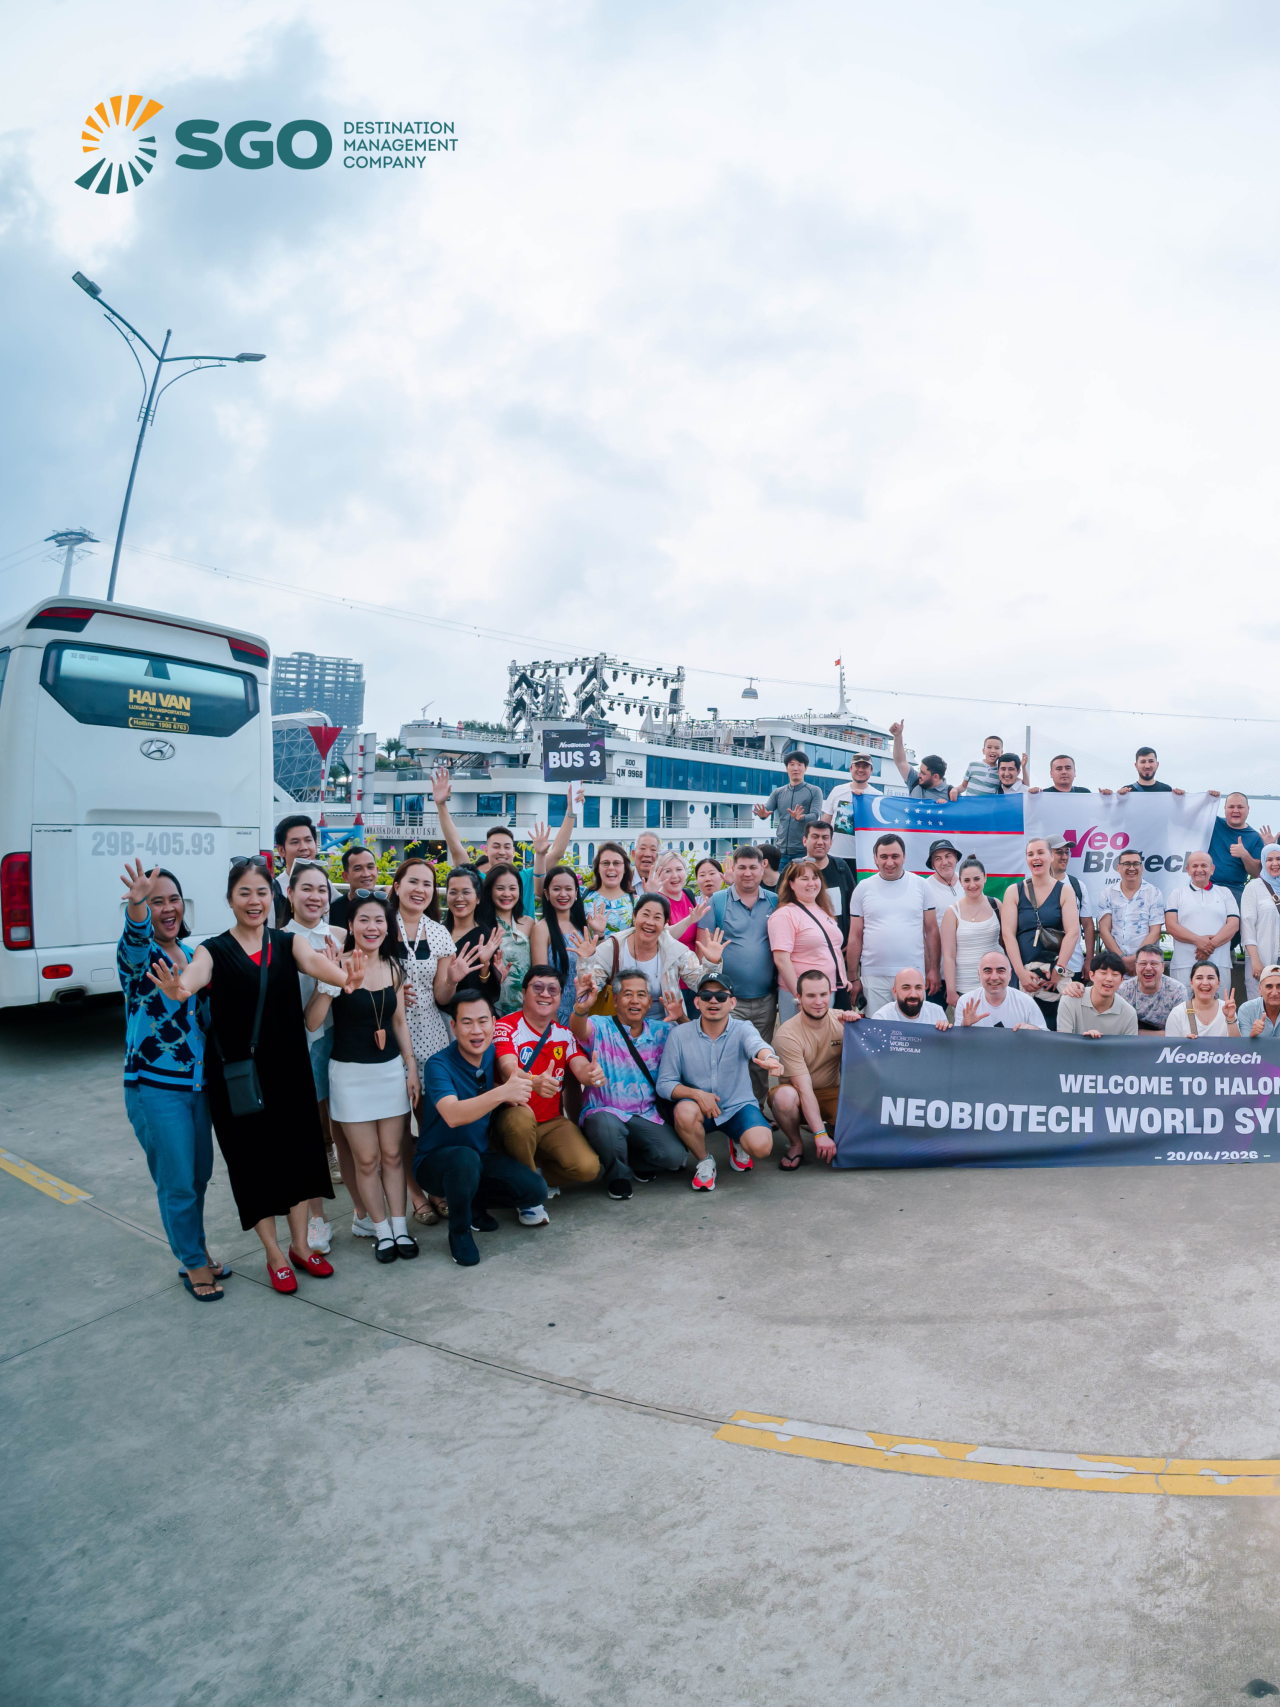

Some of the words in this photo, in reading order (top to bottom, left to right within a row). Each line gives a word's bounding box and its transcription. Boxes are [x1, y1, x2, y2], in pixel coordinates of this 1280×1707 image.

[129, 688, 157, 706] HAI
[158, 693, 190, 711] VAN
[149, 706, 190, 717] TRANSPORTATION
[548, 750, 585, 769] BUS
[589, 750, 601, 767] 3
[616, 768, 626, 777] QN
[405, 828, 438, 836] CRUISE
[1062, 825, 1130, 858] Neo
[91, 831, 216, 856] 29B-405.93
[890, 1035, 922, 1043] NEOBIOTECH
[890, 1046, 921, 1054] SYMPOSIUM
[1155, 1045, 1262, 1064] NeoBiotech
[1059, 1074, 1173, 1096] WELCOME
[1179, 1076, 1208, 1096] TO
[880, 1096, 1094, 1133] NEOBIOTECH
[1104, 1106, 1224, 1134] WORLD
